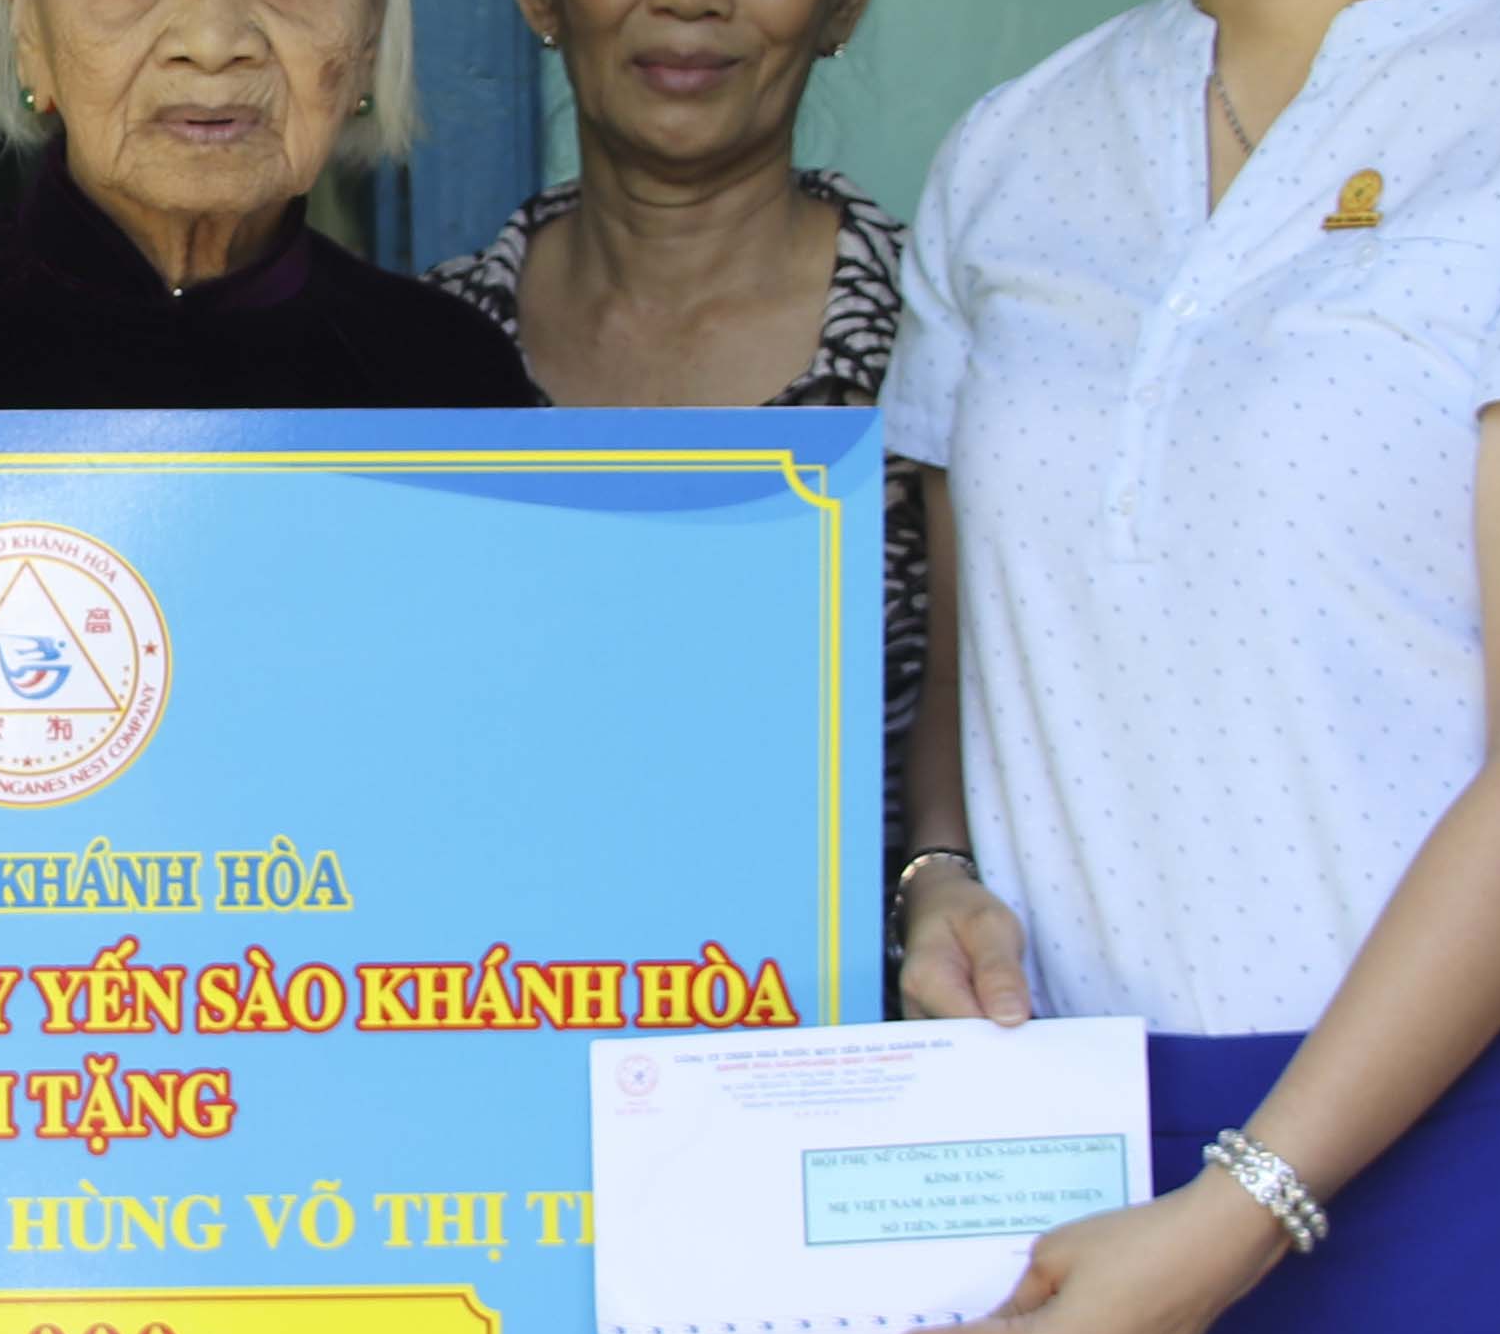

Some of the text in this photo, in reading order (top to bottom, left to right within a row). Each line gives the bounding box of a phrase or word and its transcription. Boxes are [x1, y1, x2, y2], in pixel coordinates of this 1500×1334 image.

[11, 531, 80, 557] KHÁNH
[83, 549, 118, 584] HÒA
[70, 756, 110, 785] NEST
[109, 684, 157, 759] COMPANY
[216, 835, 352, 912] HÒA
[30, 933, 183, 1034] YẾN
[197, 944, 347, 1033] SÀO
[355, 941, 625, 1031] KHÁNH
[634, 941, 798, 1027] HÒA
[30, 1053, 236, 1154] TẶNG
[6, 1179, 226, 1253] HÙNG
[246, 1179, 357, 1250] VÕ
[373, 1191, 509, 1263] THỊ
